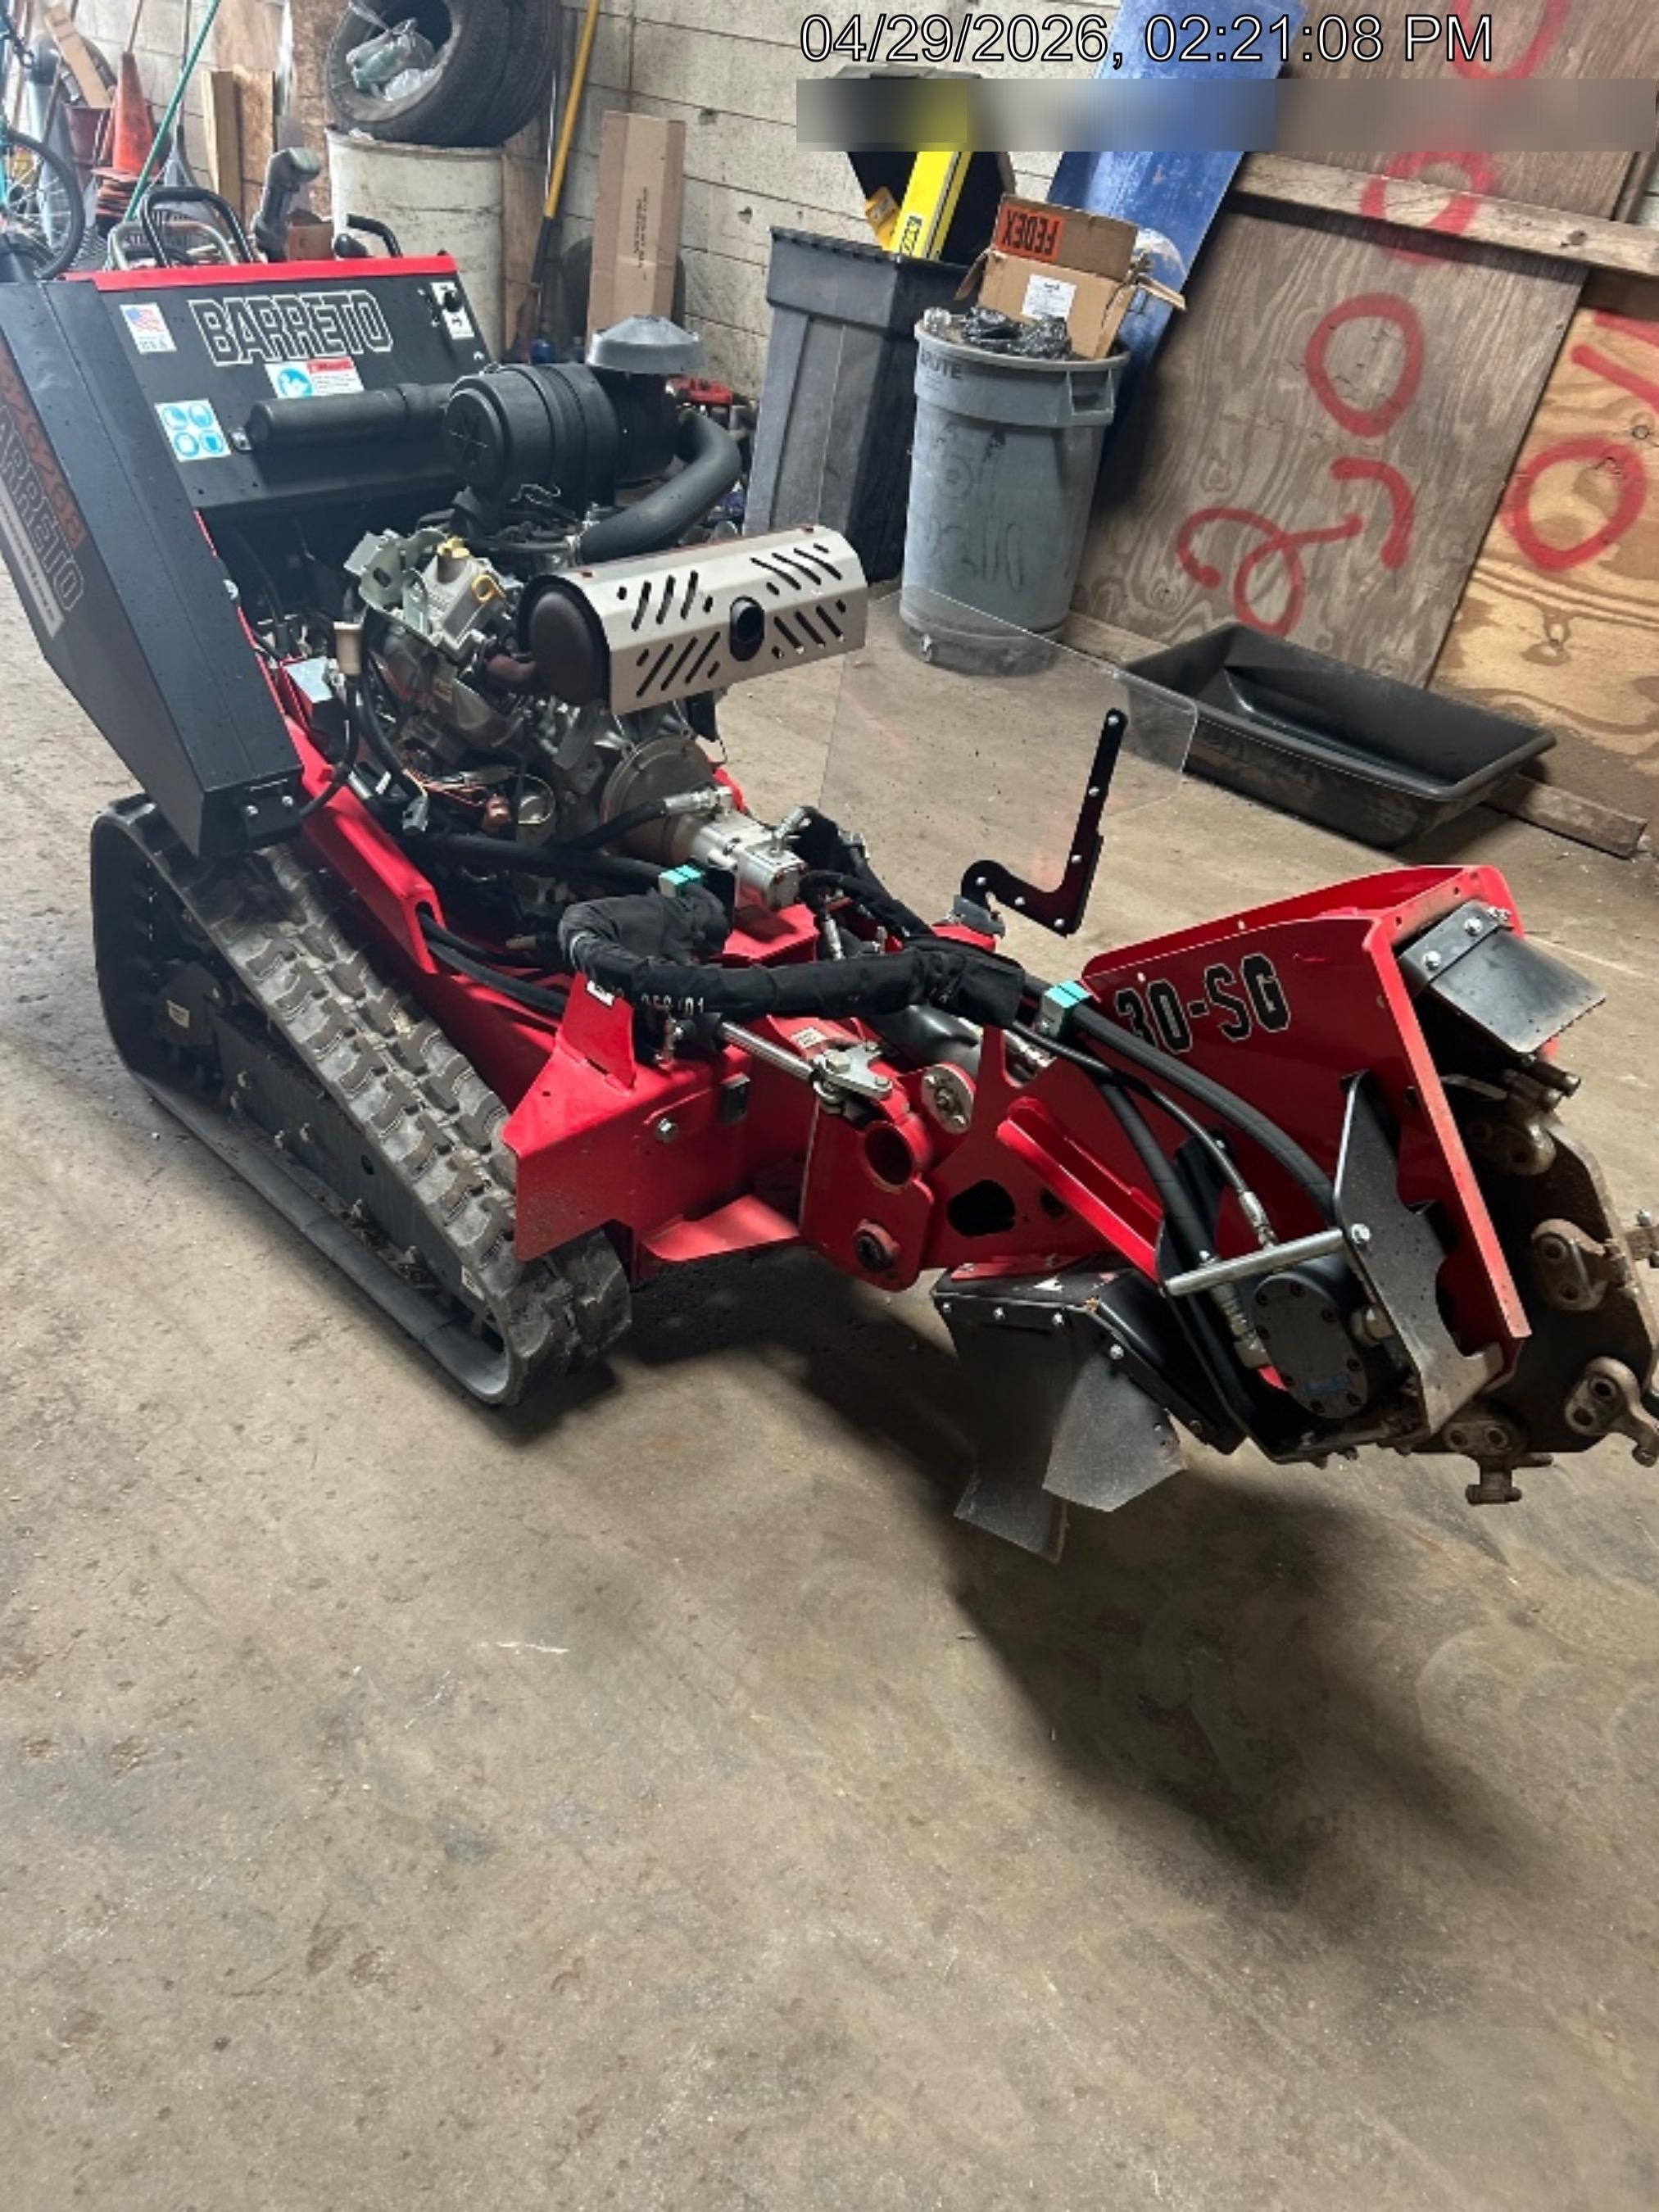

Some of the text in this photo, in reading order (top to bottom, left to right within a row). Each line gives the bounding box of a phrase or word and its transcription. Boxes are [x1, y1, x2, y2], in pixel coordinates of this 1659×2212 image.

[1002, 208, 1061, 256] FEDEX
[186, 289, 394, 366] BARRETO
[918, 348, 963, 379] RUTE
[1114, 952, 1292, 1054] 30-SG
